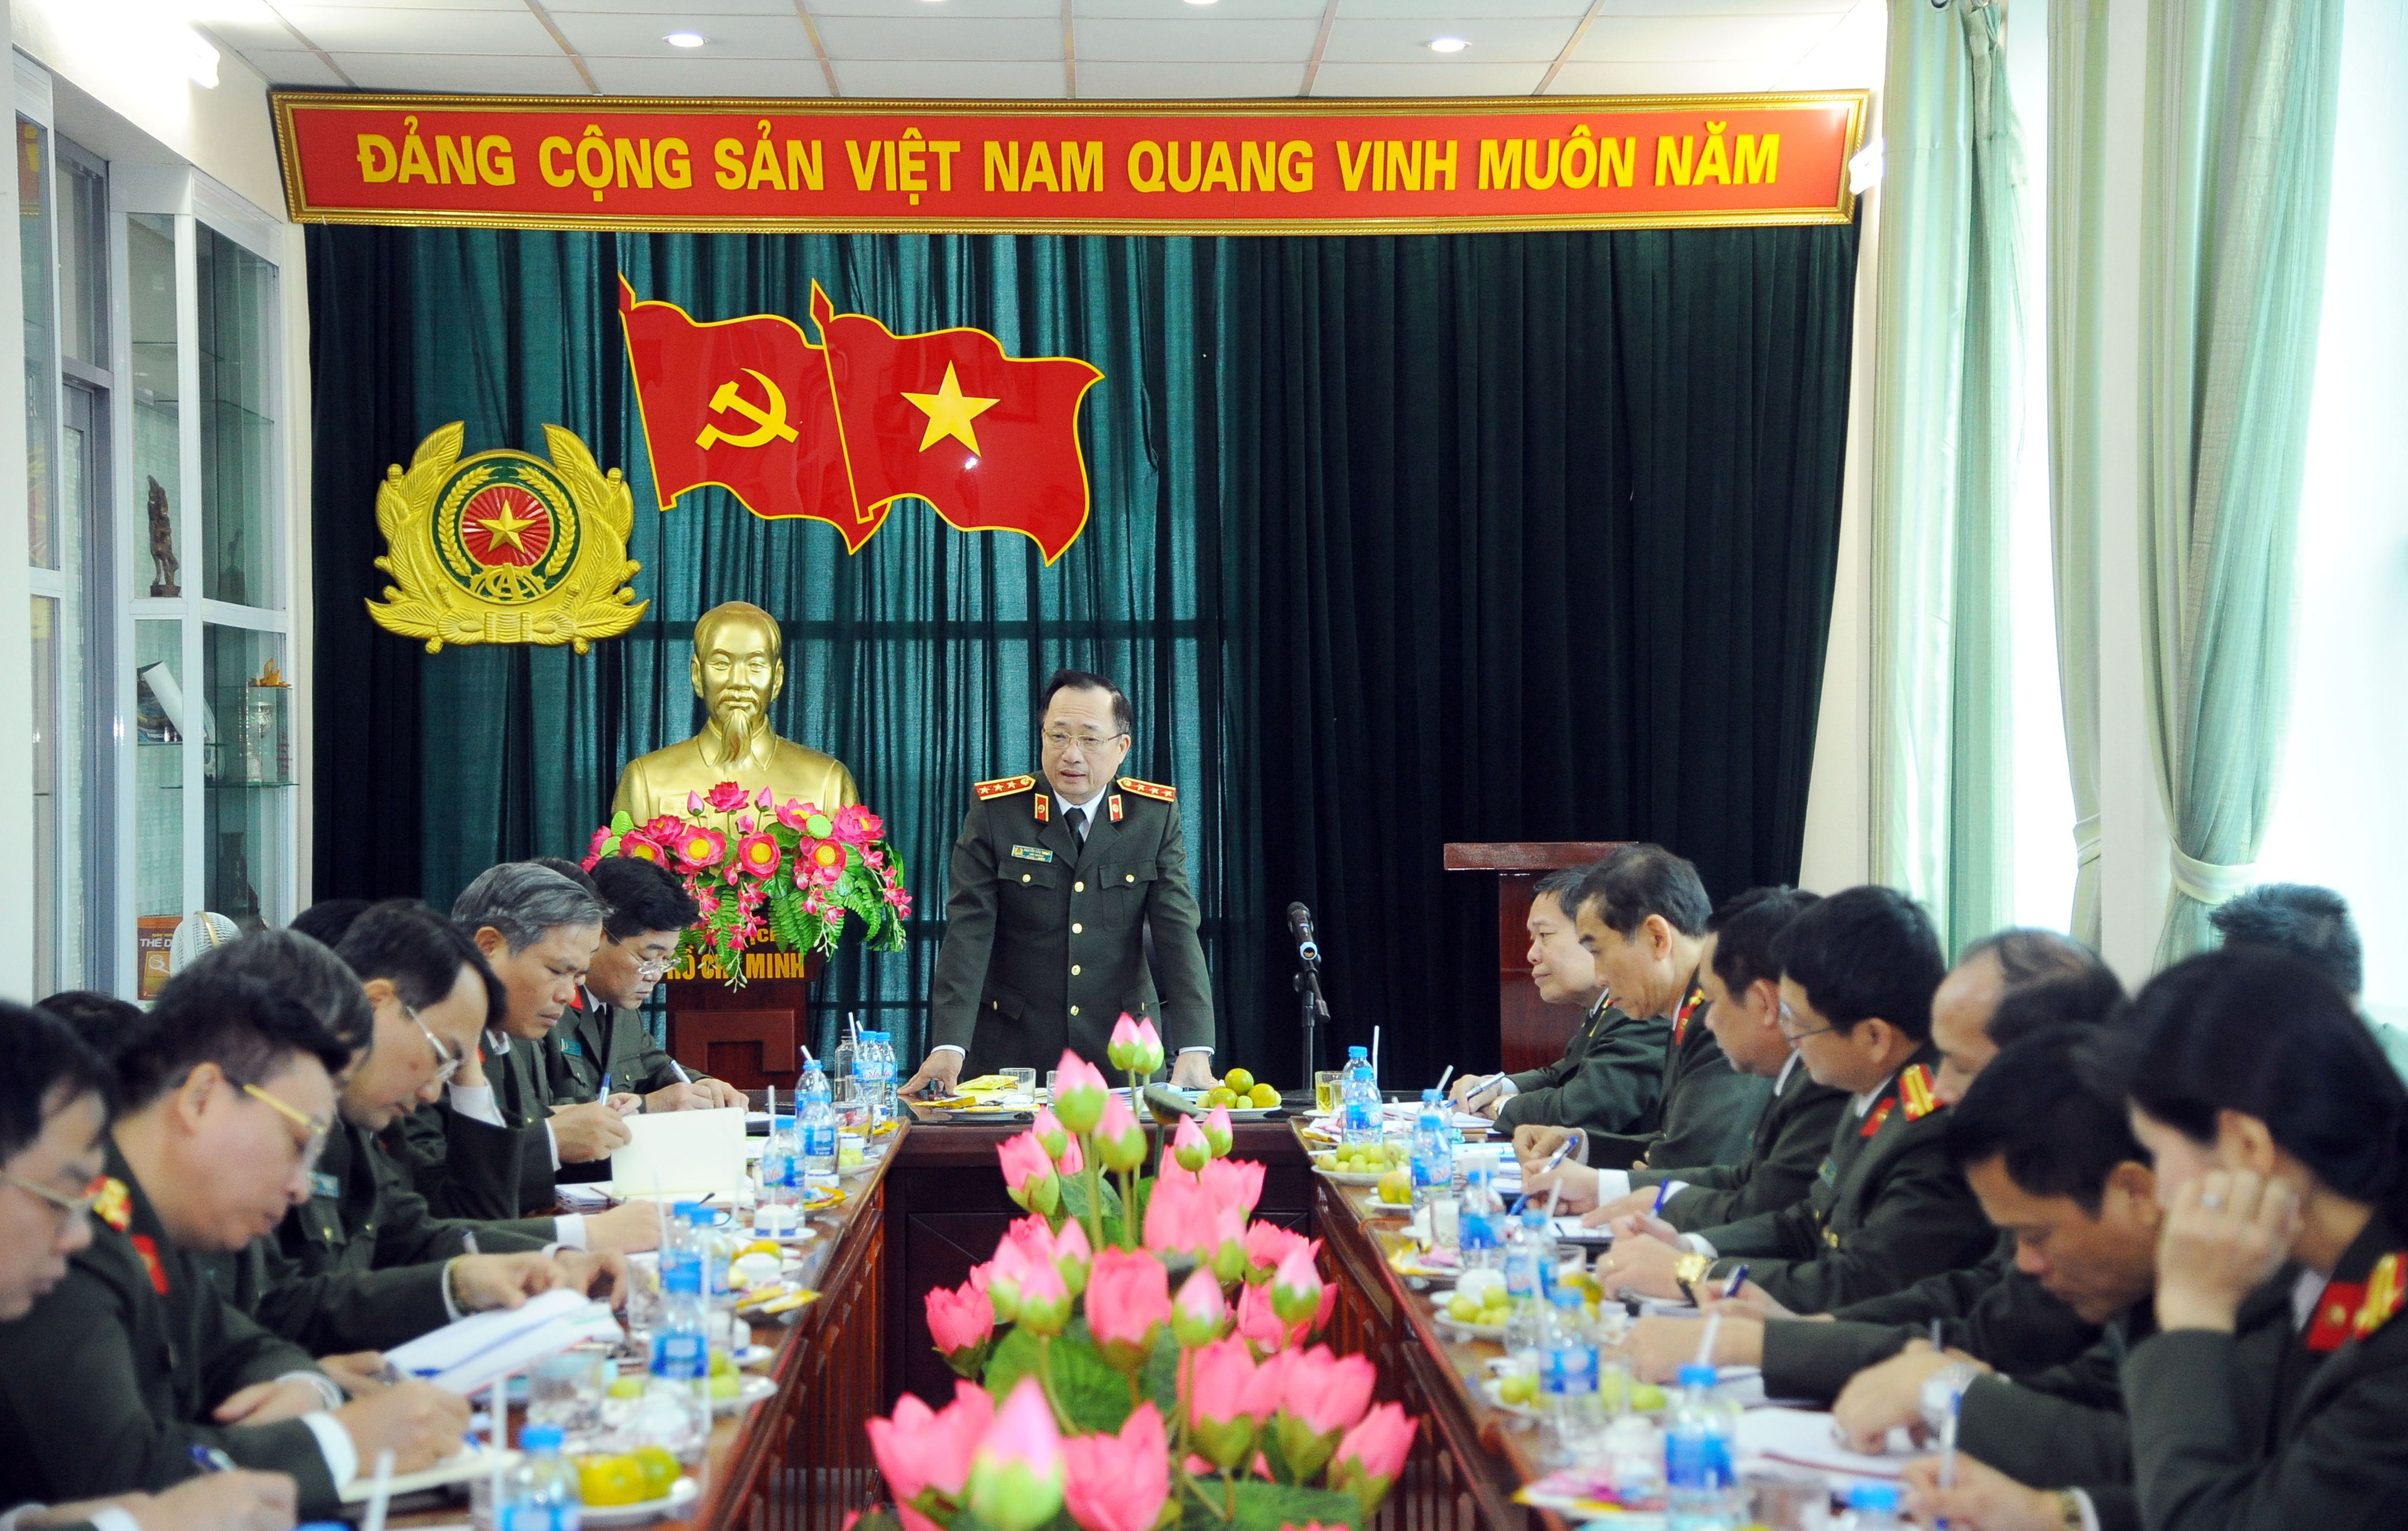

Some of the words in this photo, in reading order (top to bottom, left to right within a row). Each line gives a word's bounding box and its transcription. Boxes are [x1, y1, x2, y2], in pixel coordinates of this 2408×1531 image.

[357, 116, 516, 186] ĐẢNG
[539, 124, 692, 202] CỘNG
[714, 120, 824, 191] SẢN
[845, 127, 960, 206] VIỆT
[984, 141, 1104, 192] NAM
[1128, 140, 1313, 193] QUANG
[1336, 140, 1458, 192] VINH
[1478, 124, 1637, 190] MUÔN
[1655, 121, 1780, 187] NĂM
[701, 953, 729, 979] CH
[746, 953, 804, 979] MINH
